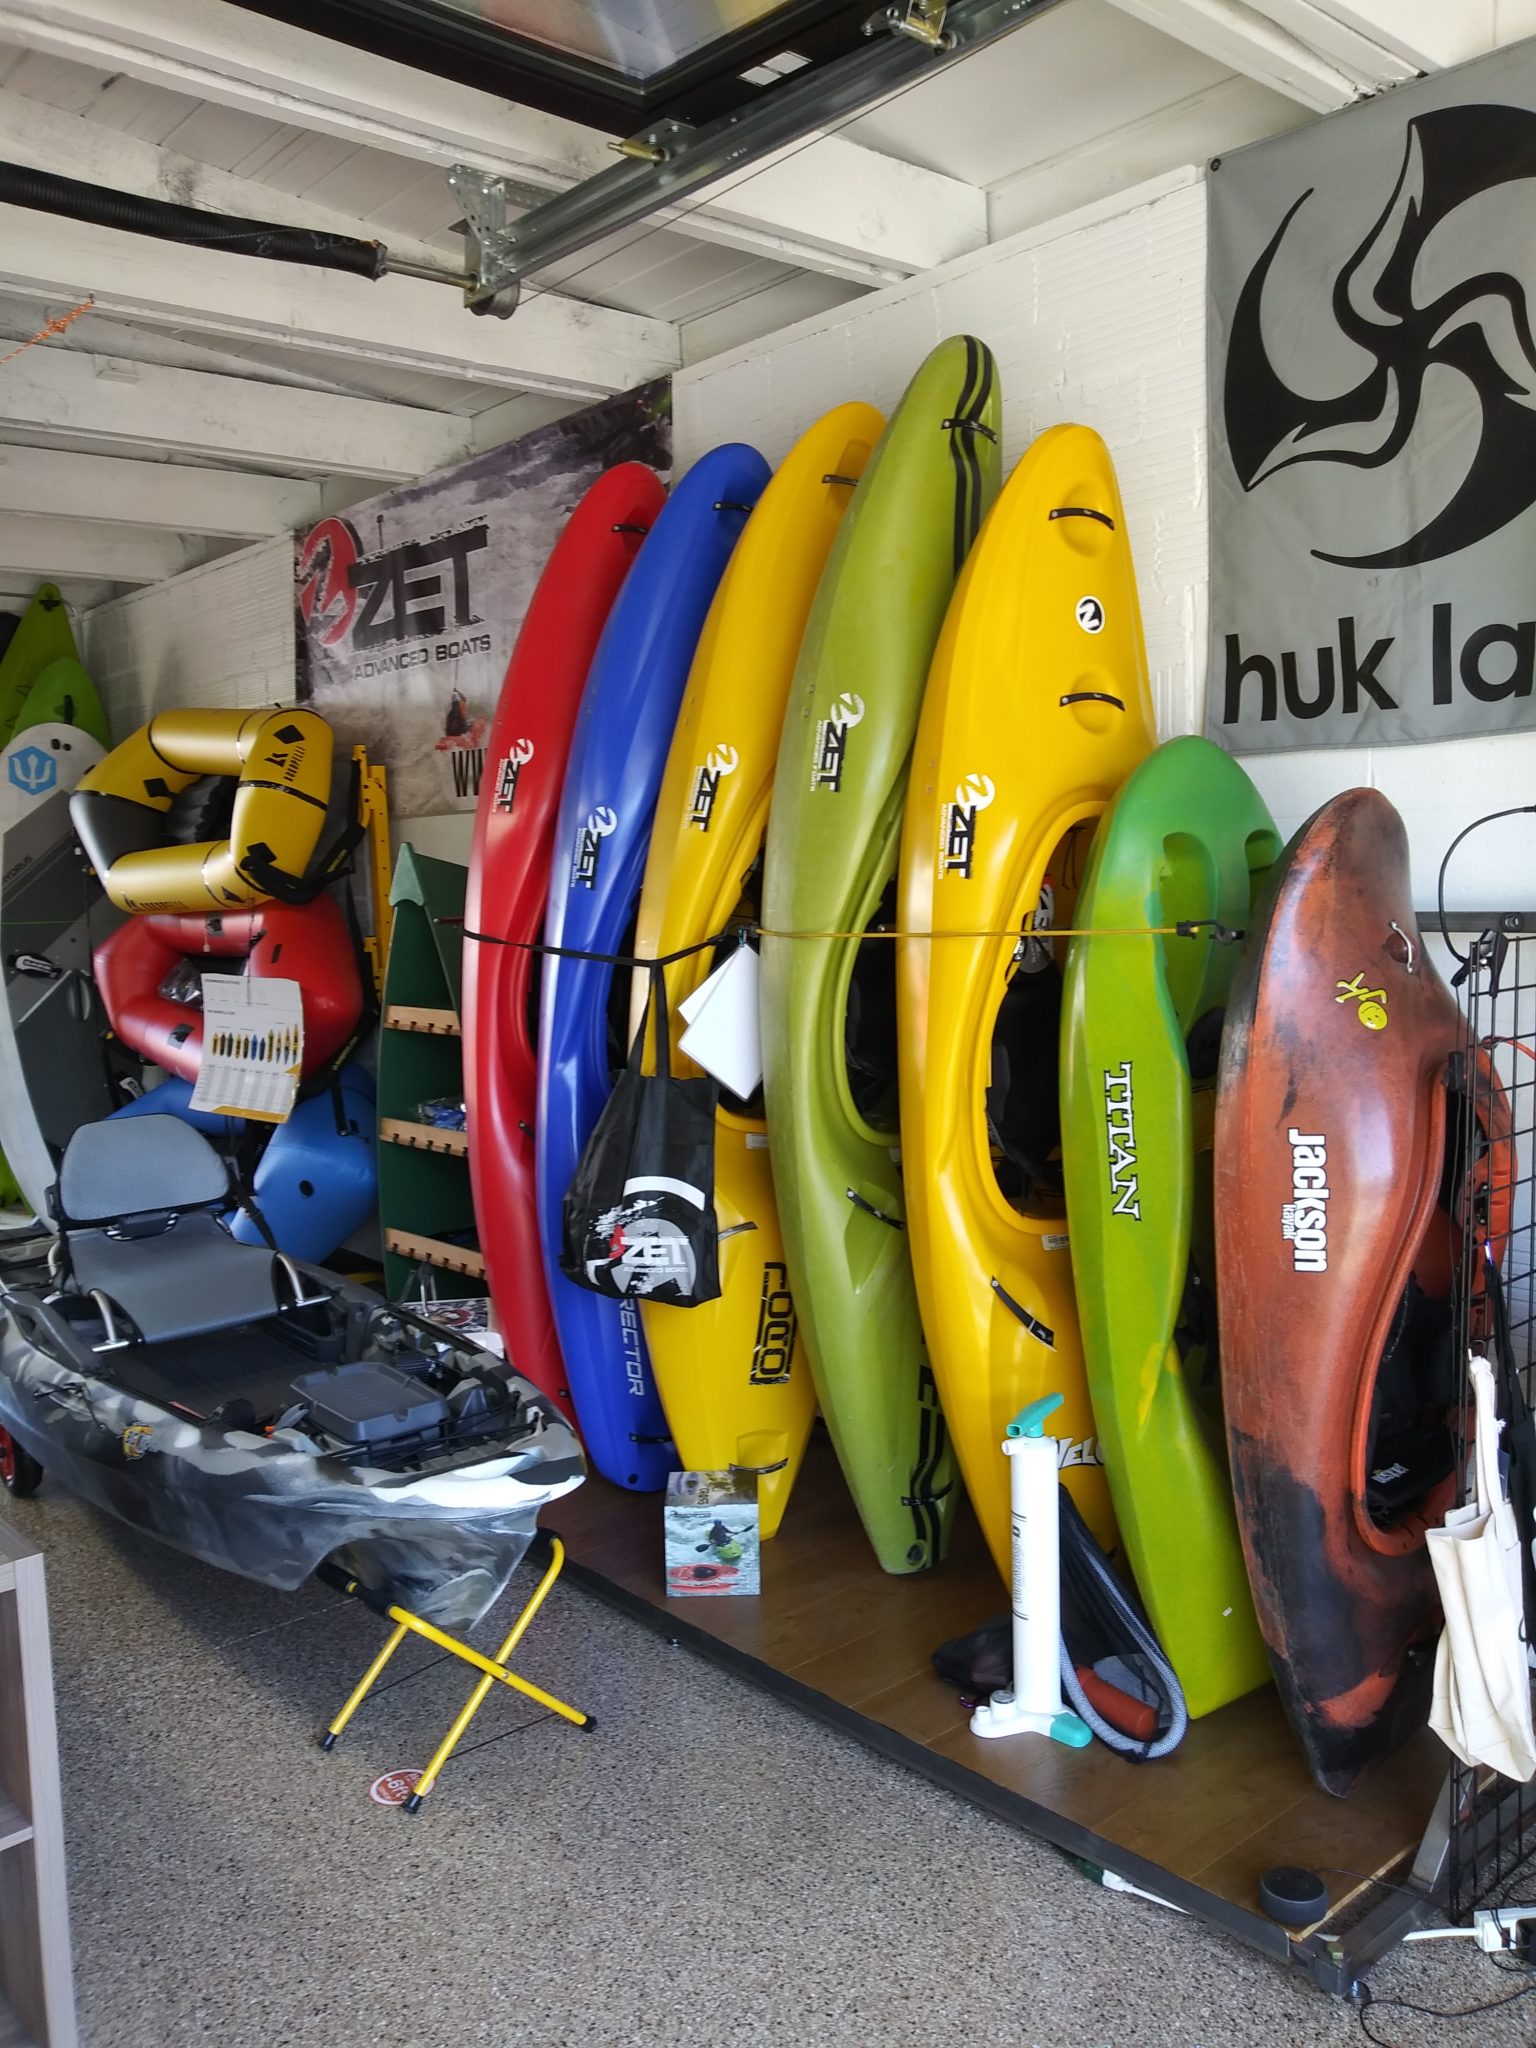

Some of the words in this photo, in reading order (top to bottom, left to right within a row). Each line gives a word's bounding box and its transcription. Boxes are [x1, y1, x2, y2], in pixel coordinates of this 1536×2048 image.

[347, 520, 489, 650] ZET
[353, 646, 429, 681] ADVANCED
[435, 634, 492, 662] BOATS
[1223, 616, 1399, 725] huk
[498, 760, 521, 813] ZET
[819, 721, 849, 793] ZET
[690, 767, 722, 832] ZET
[578, 830, 602, 890] ZET
[945, 804, 977, 880] ZET
[1104, 1060, 1142, 1222] TITAN
[1281, 1203, 1298, 1240] kayak
[1287, 1127, 1331, 1273] Jackson
[620, 1235, 690, 1265] ZET
[619, 1299, 644, 1396] RECTOR
[1053, 1435, 1104, 1470] VEL
